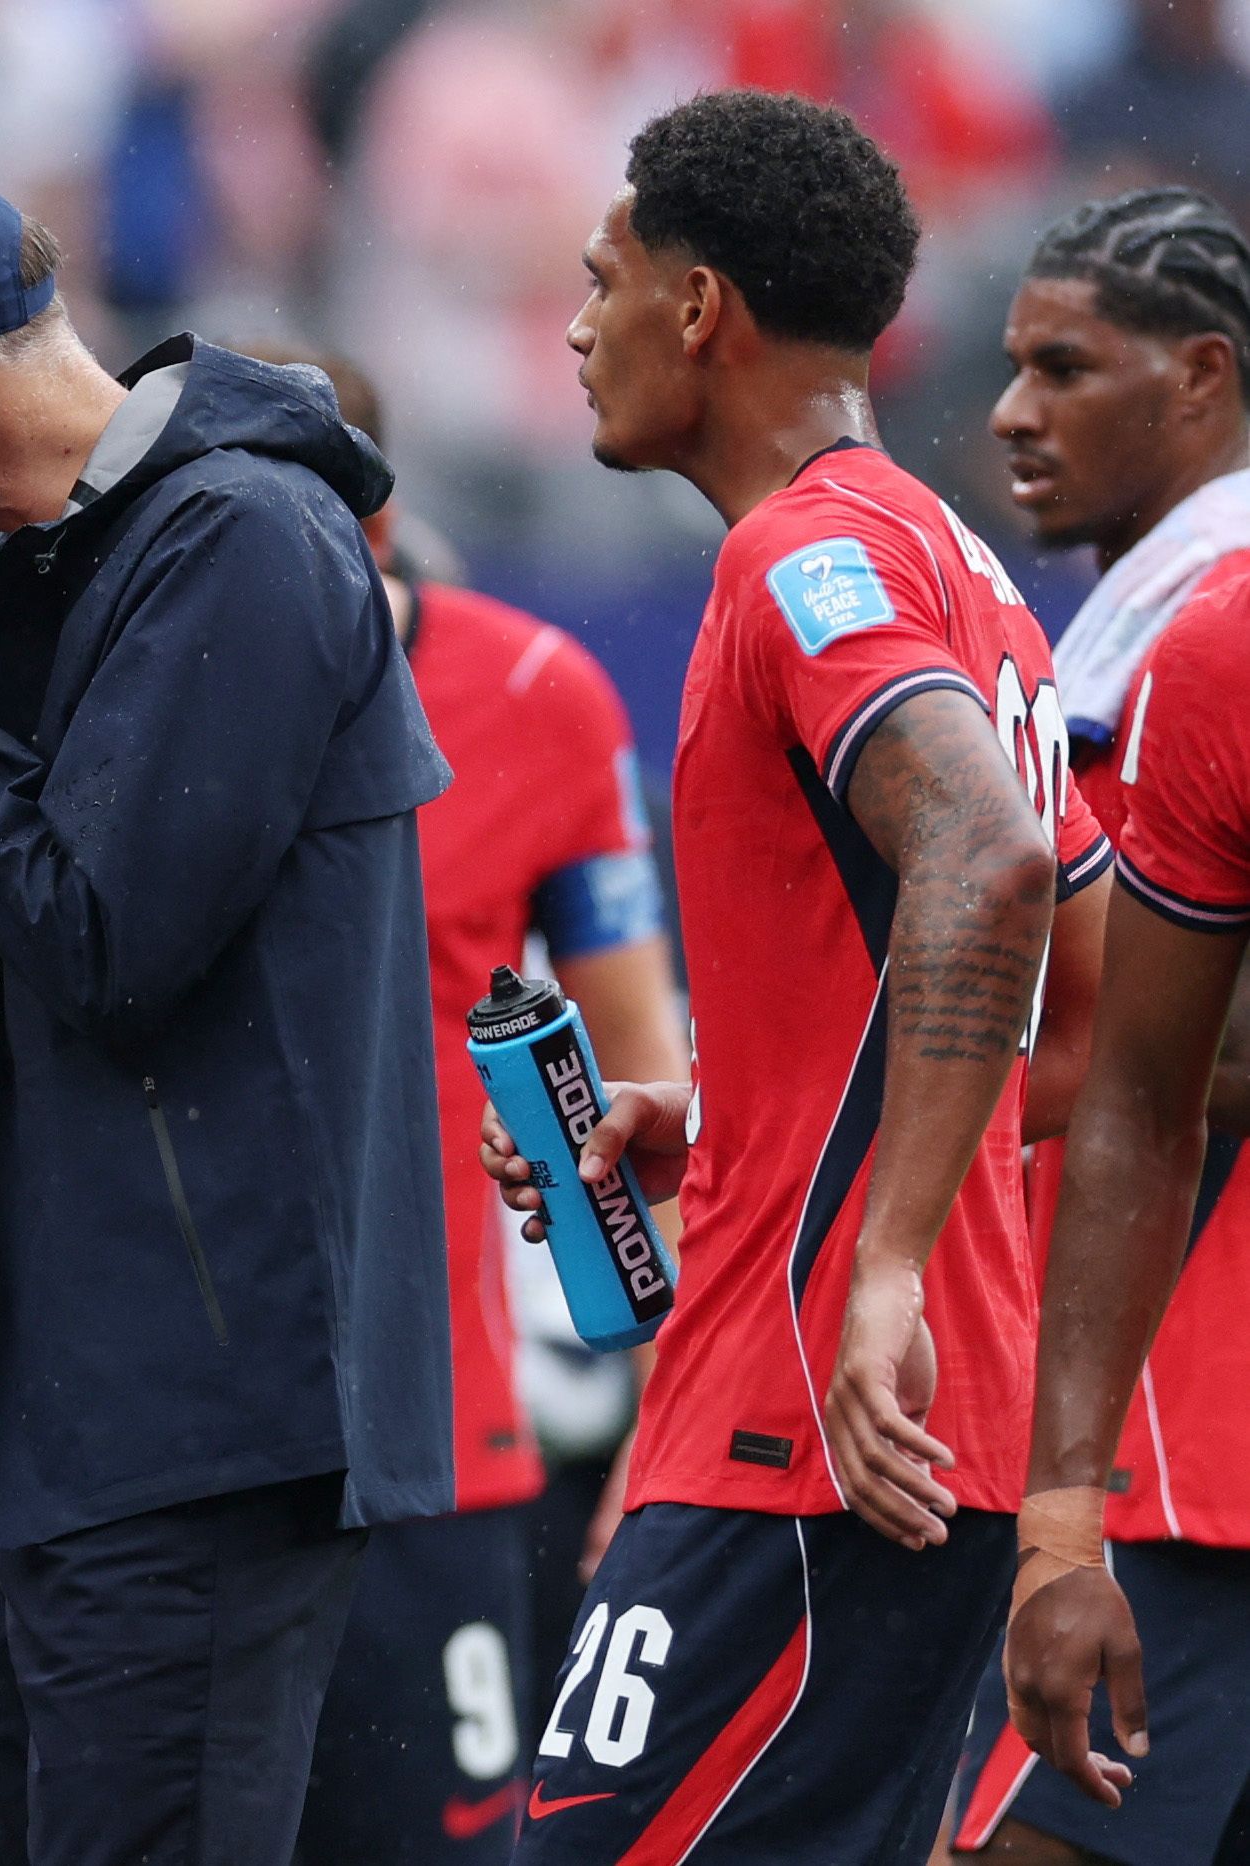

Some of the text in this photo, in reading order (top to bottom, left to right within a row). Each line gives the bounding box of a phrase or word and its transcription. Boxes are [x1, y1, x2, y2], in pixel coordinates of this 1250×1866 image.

[812, 590, 862, 622] PEACE
[470, 1011, 539, 1040] POWERADE
[545, 1049, 667, 1301] POWEADE
[441, 1619, 519, 1781] 9
[538, 1602, 674, 1768] 26
